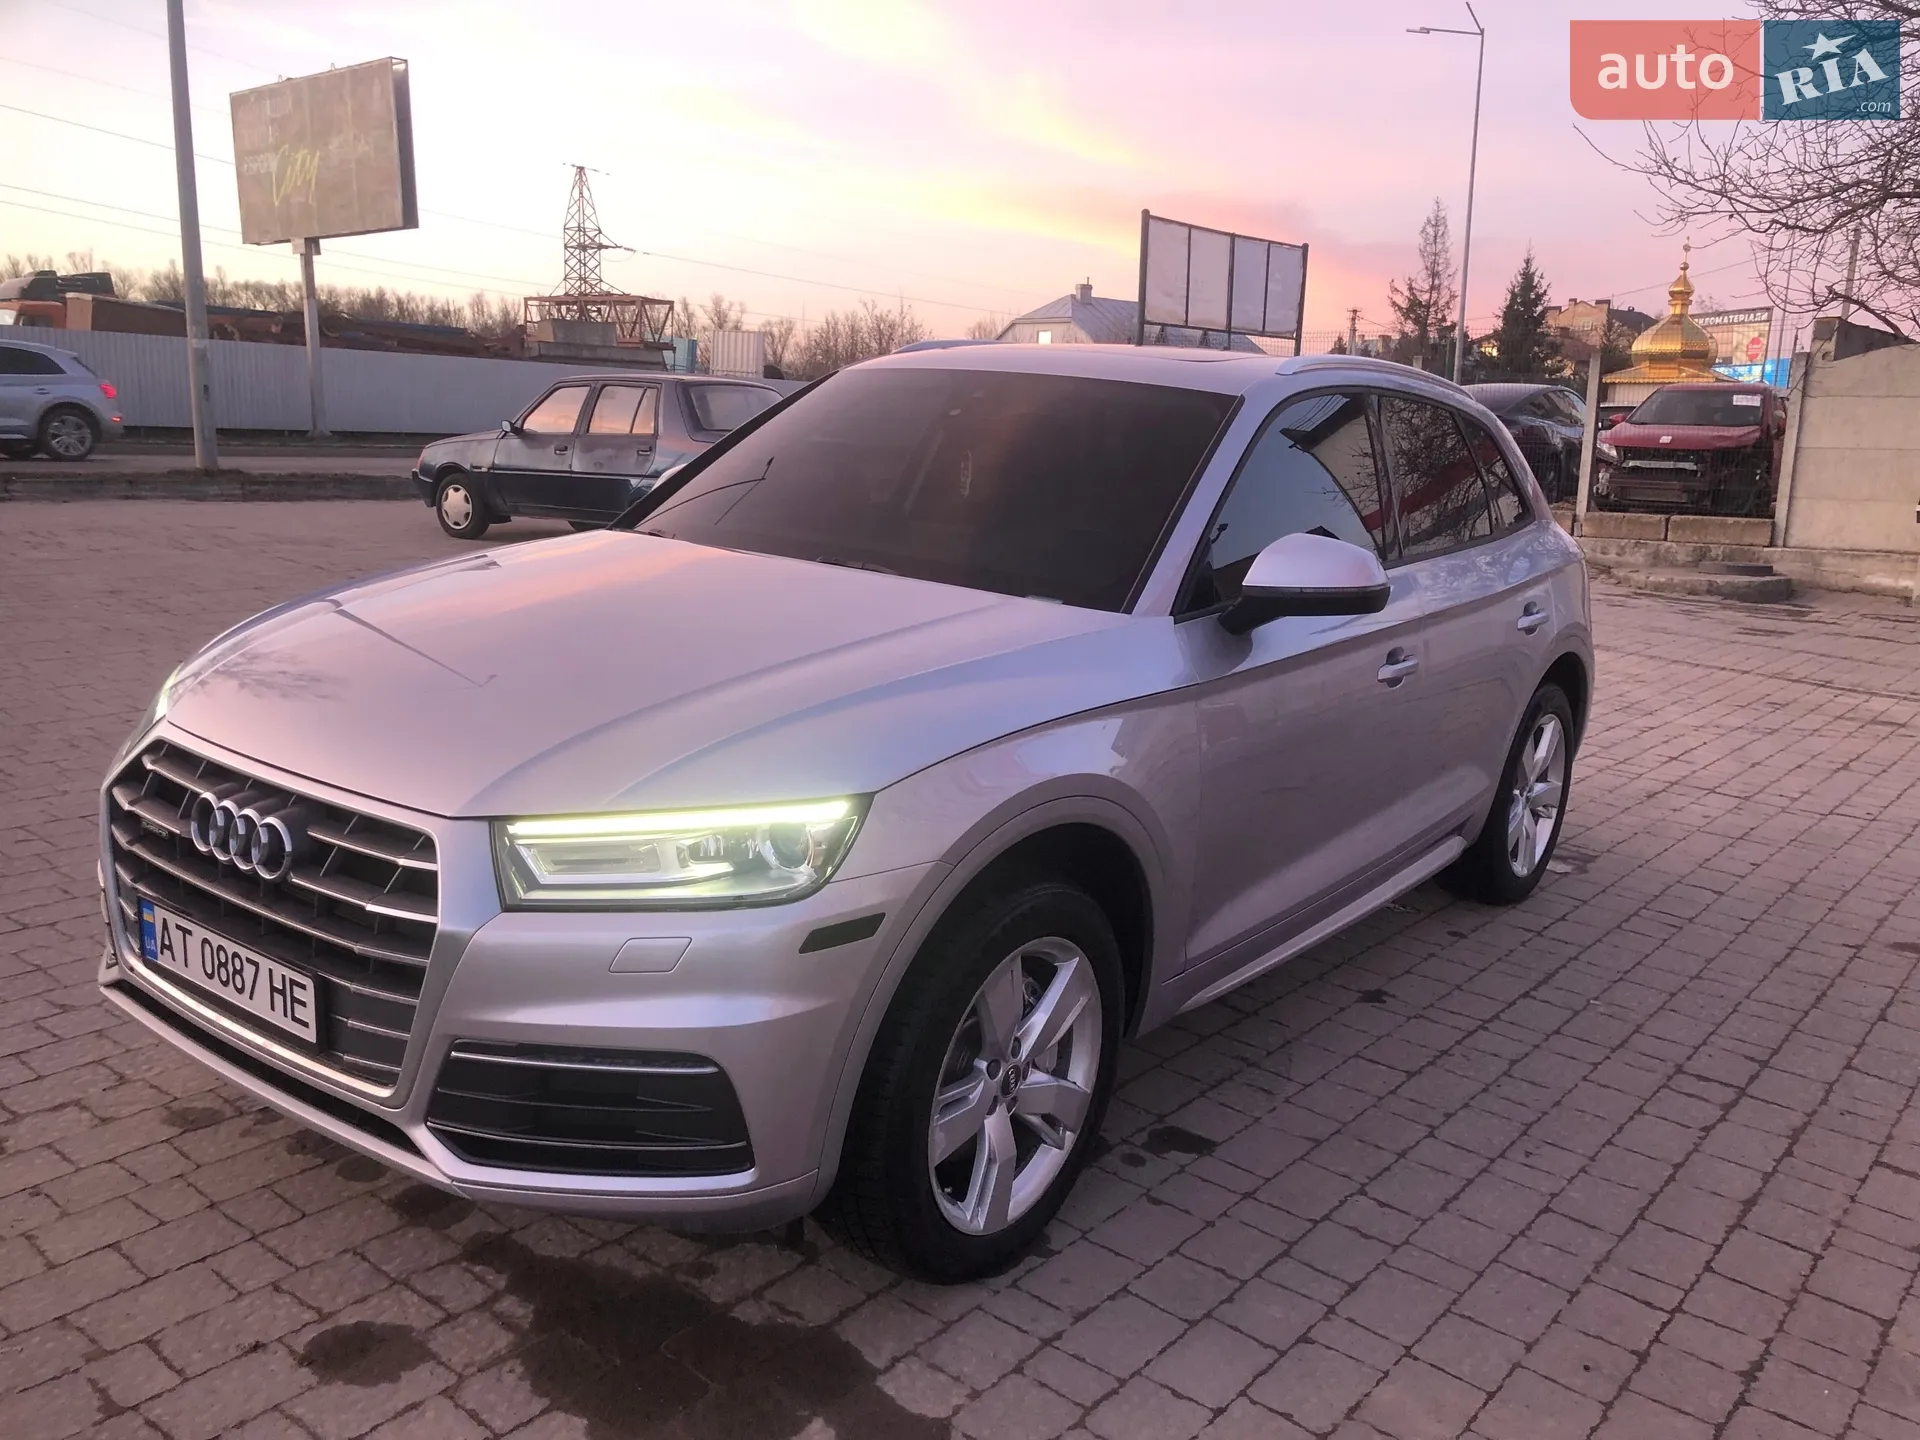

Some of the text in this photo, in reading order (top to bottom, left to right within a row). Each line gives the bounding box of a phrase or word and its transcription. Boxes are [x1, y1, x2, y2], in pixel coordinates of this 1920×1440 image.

[144, 935, 156, 951] UA
[160, 917, 310, 1029] AT 0887 HE
